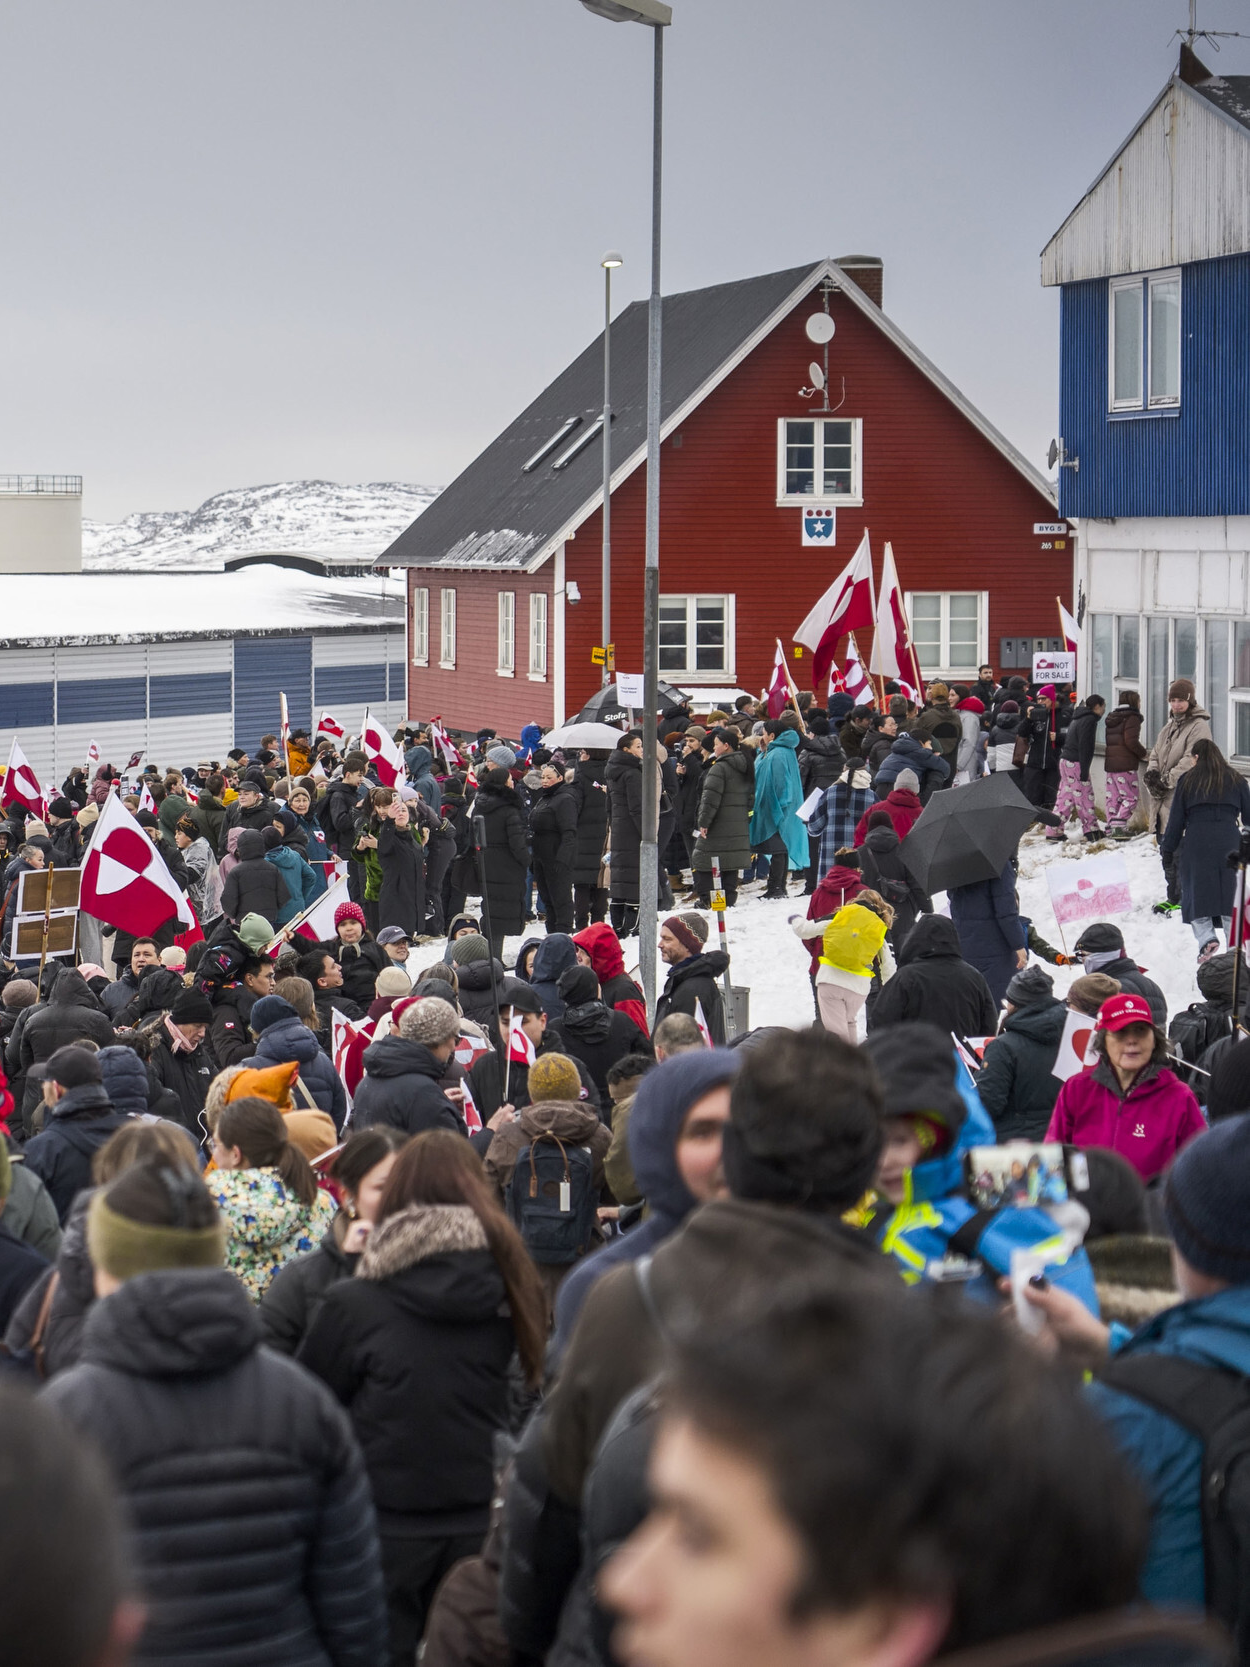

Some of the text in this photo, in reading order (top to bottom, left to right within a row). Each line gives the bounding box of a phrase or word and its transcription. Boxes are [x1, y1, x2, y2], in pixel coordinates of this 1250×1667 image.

[1054, 661, 1070, 669] NOT
[1035, 671, 1070, 680] FOR SALE
[604, 711, 627, 722] Stofa
